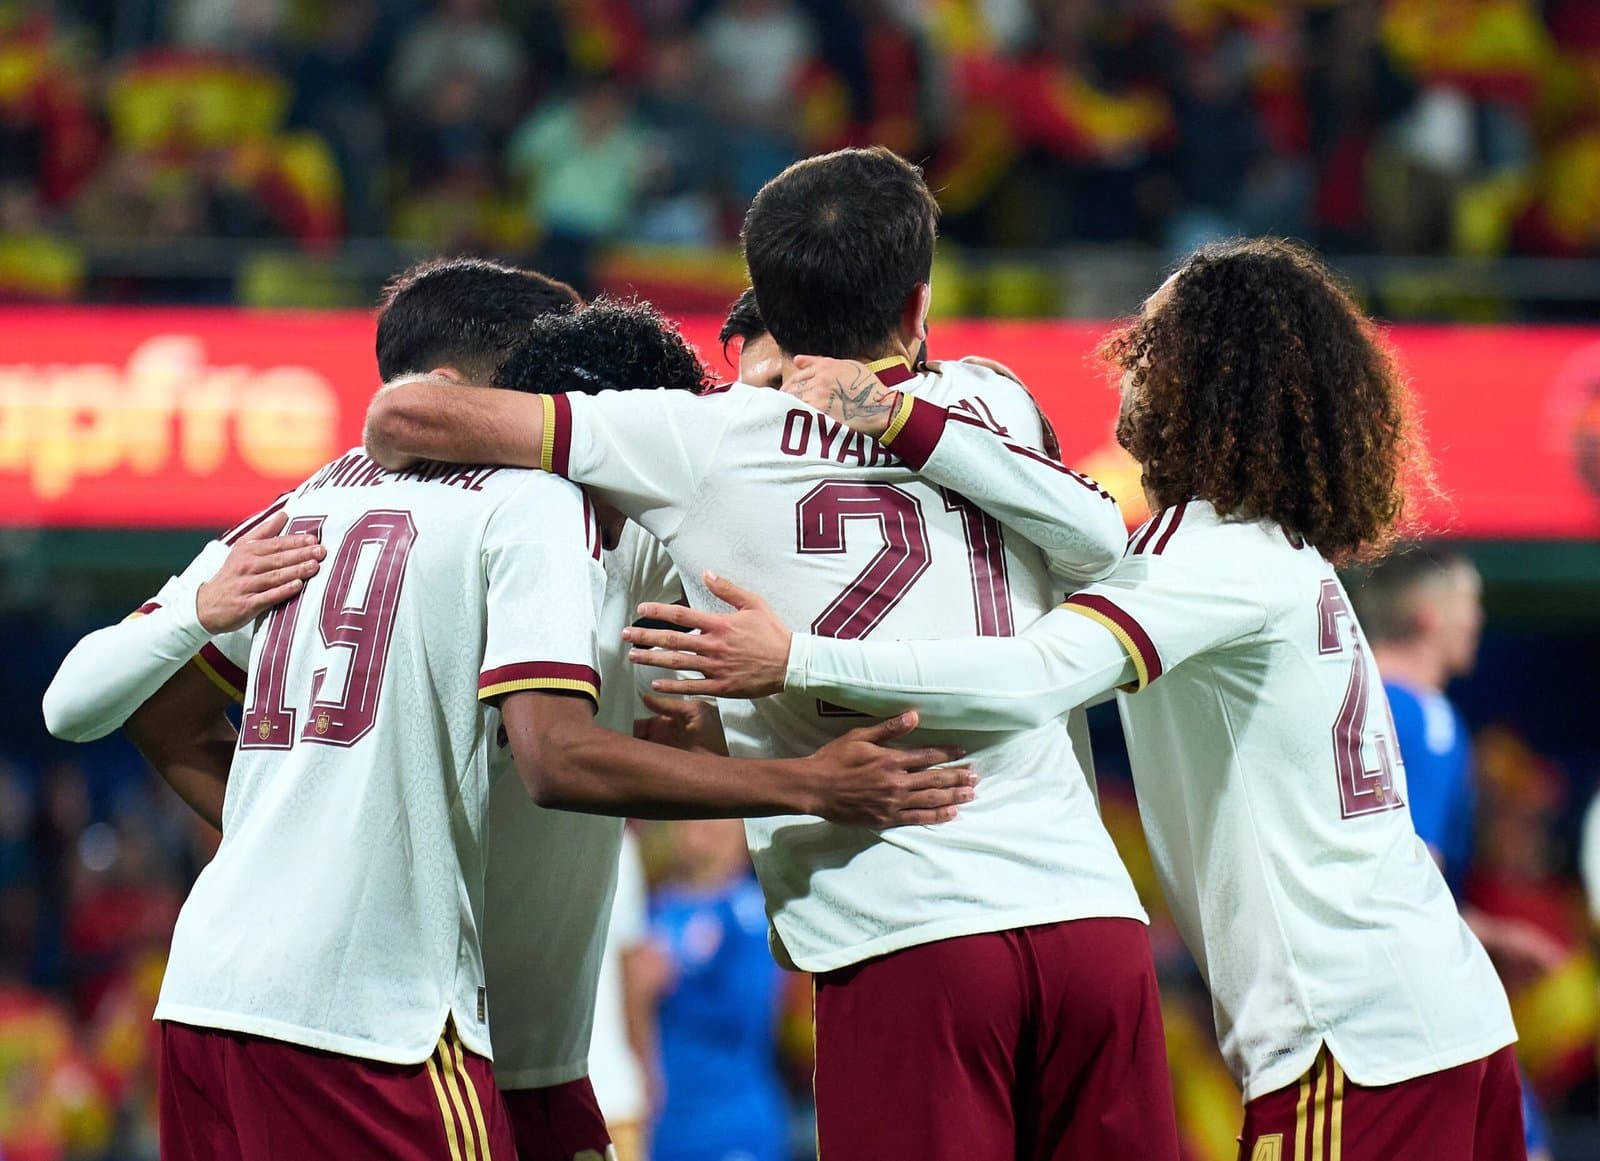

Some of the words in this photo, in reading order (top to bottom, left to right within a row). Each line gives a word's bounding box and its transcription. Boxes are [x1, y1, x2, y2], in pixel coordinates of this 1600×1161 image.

[239, 509, 418, 751] 19
[796, 479, 1015, 716] 21
[1316, 578, 1405, 820] 2
